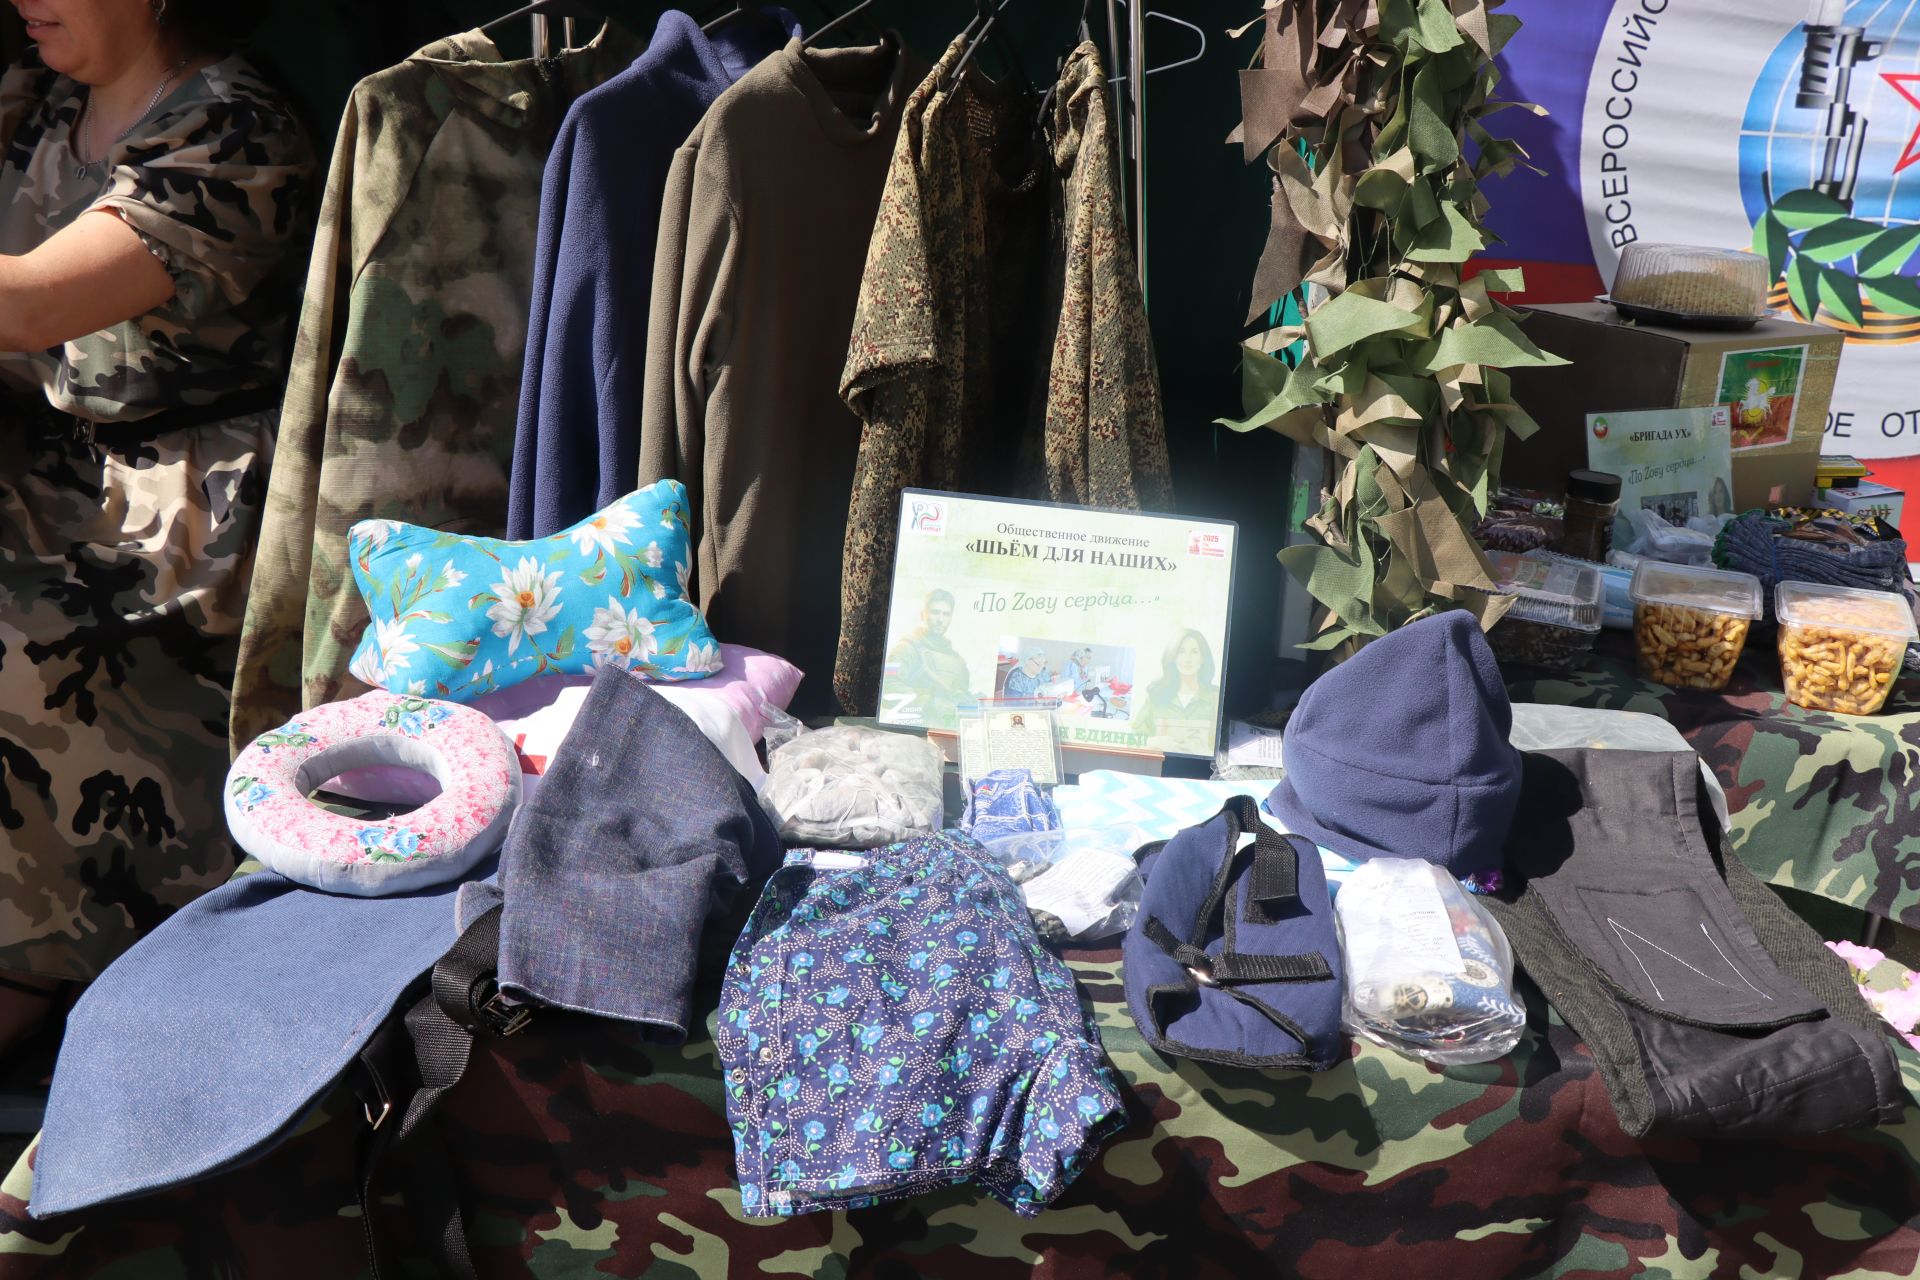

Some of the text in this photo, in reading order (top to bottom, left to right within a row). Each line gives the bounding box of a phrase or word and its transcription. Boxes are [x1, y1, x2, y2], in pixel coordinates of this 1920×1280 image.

[1630, 428, 1691, 442] «БРИГАДА УХ»
[996, 522, 1150, 548] Общественное движение
[1202, 534, 1219, 543] 2025
[965, 539, 1177, 572] «ШЬЁМ ДЛЯ НАШИХ»
[973, 592, 1006, 613] «По
[1012, 592, 1058, 614] Zову
